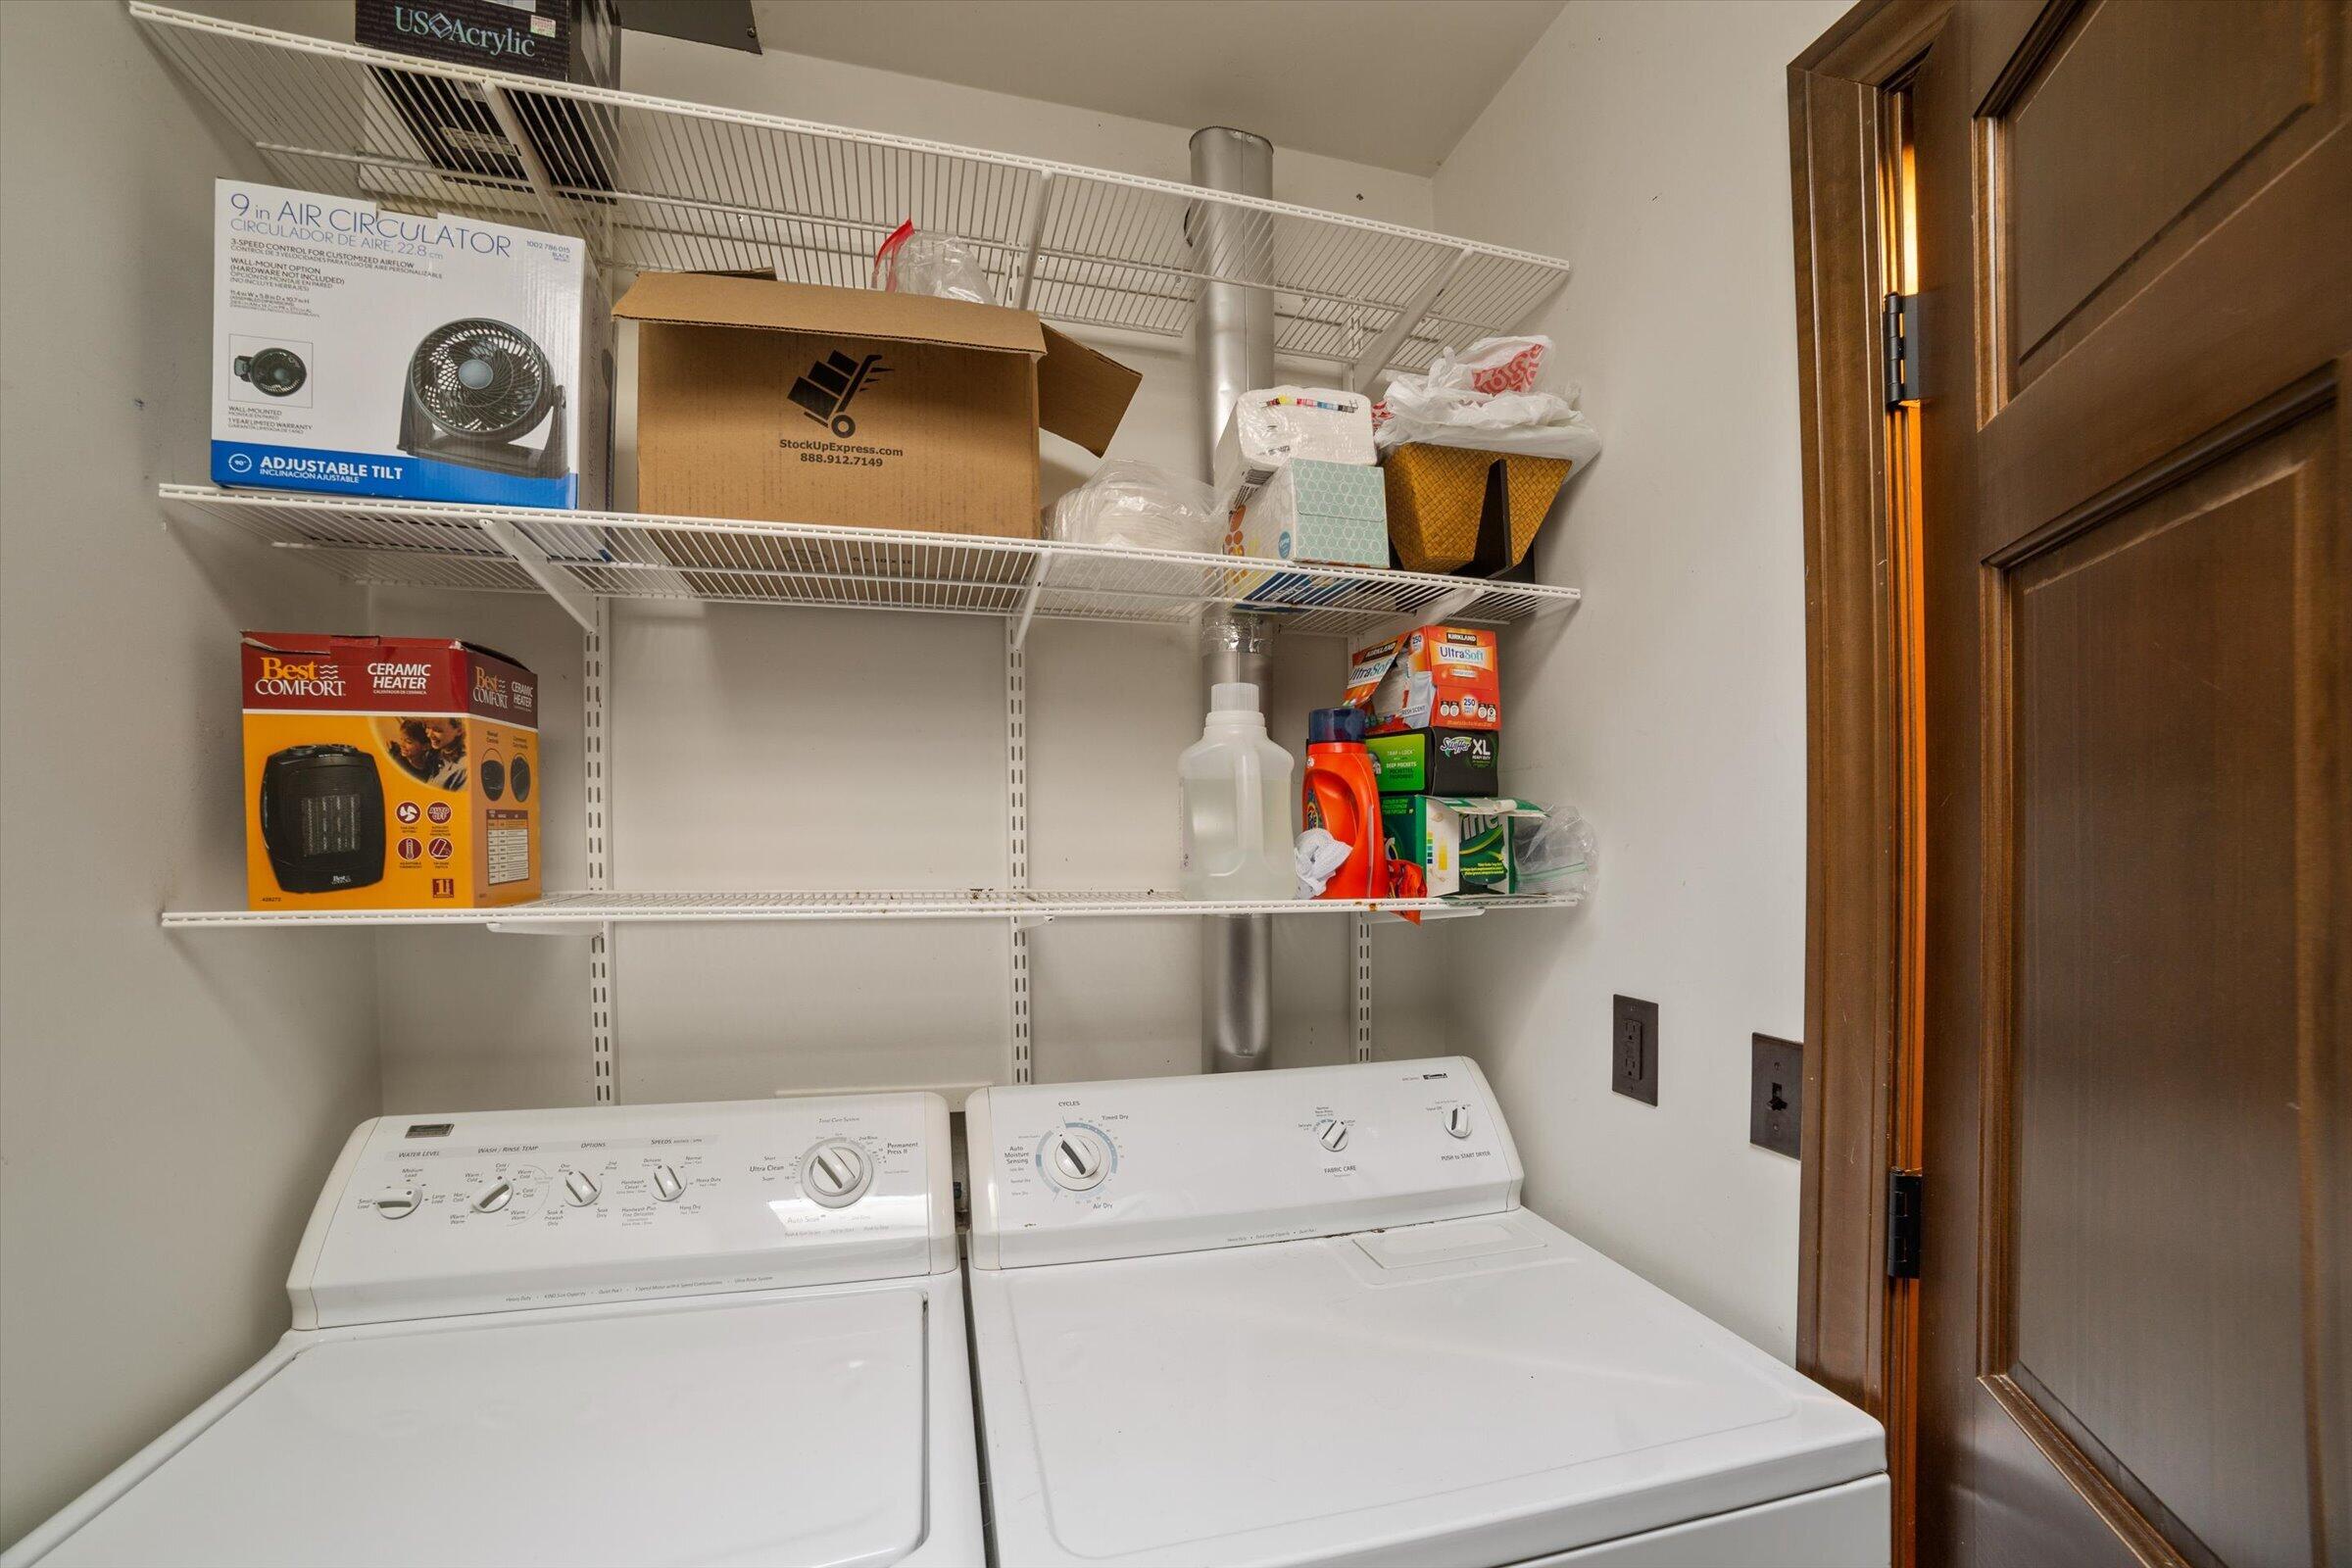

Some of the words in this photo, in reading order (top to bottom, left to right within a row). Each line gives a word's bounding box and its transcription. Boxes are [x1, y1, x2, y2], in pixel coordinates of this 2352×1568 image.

[394, 6, 429, 35] US
[449, 19, 535, 57] Acrylic
[230, 193, 249, 217] 9
[256, 205, 270, 220] in
[277, 201, 321, 227] AIR
[329, 208, 511, 258] CIRCULATOR
[230, 218, 334, 244] CIRCULADOR
[338, 233, 356, 247] DE
[398, 241, 426, 257] 22.8
[266, 243, 307, 255] CONTROL
[325, 251, 378, 264] CUSTOMIZED
[380, 259, 415, 269] AIRFLOW
[288, 265, 320, 274] OPTION
[779, 439, 904, 457] StockUpExpress.com
[260, 456, 368, 477] ADJUSTABLE
[371, 465, 403, 480] TILT
[800, 453, 883, 467] 888.912.7149
[260, 468, 317, 480] INCLINACIÓN
[317, 472, 360, 484] AJUSTABLE
[1447, 633, 1477, 642] KIRKLAND
[1441, 646, 1484, 661] UltraSoft
[260, 657, 318, 680] Best
[368, 662, 431, 676] CERAMIC
[255, 678, 345, 697] COMFORT
[372, 676, 426, 690] HEATER
[475, 666, 498, 692] Best
[473, 687, 508, 709] COMFORT
[512, 681, 533, 698] CERAMIC
[514, 693, 532, 708] HEATER
[1440, 737, 1471, 755] Swiffer
[1472, 739, 1491, 756] XL
